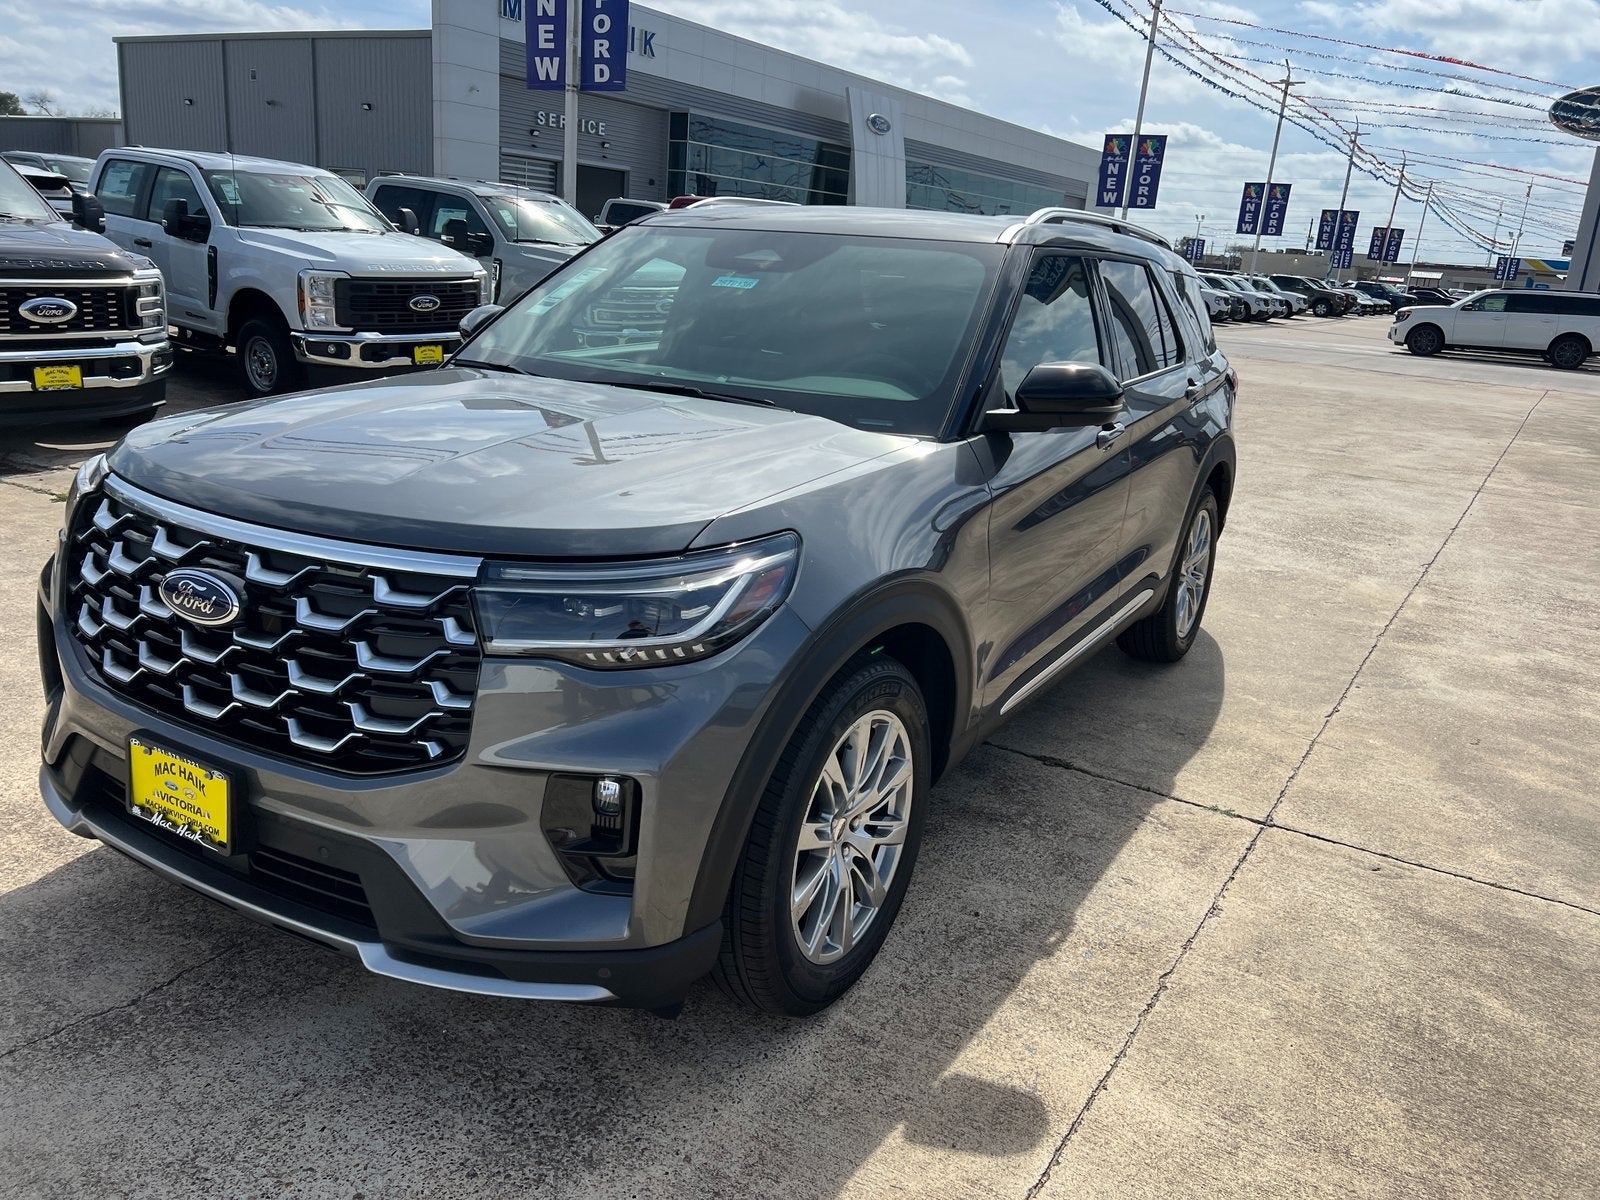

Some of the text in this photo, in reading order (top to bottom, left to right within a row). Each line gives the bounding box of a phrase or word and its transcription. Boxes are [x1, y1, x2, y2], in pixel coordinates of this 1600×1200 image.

[534, 0, 560, 81] NEW
[537, 110, 606, 136] SERICE
[1103, 163, 1119, 203] NEW
[1136, 164, 1152, 206] FORD
[1241, 203, 1256, 232] NEW
[1267, 204, 1280, 234] FORD
[1320, 225, 1331, 248] NEW
[1340, 226, 1350, 250] FORD
[1370, 240, 1381, 259] NEW
[1387, 241, 1397, 260] FORD
[172, 579, 217, 614] Ford
[154, 762, 177, 777] MAC
[178, 765, 206, 798] HAIK
[160, 790, 203, 818] VICTORIA
[150, 811, 204, 844] Mac Haik
